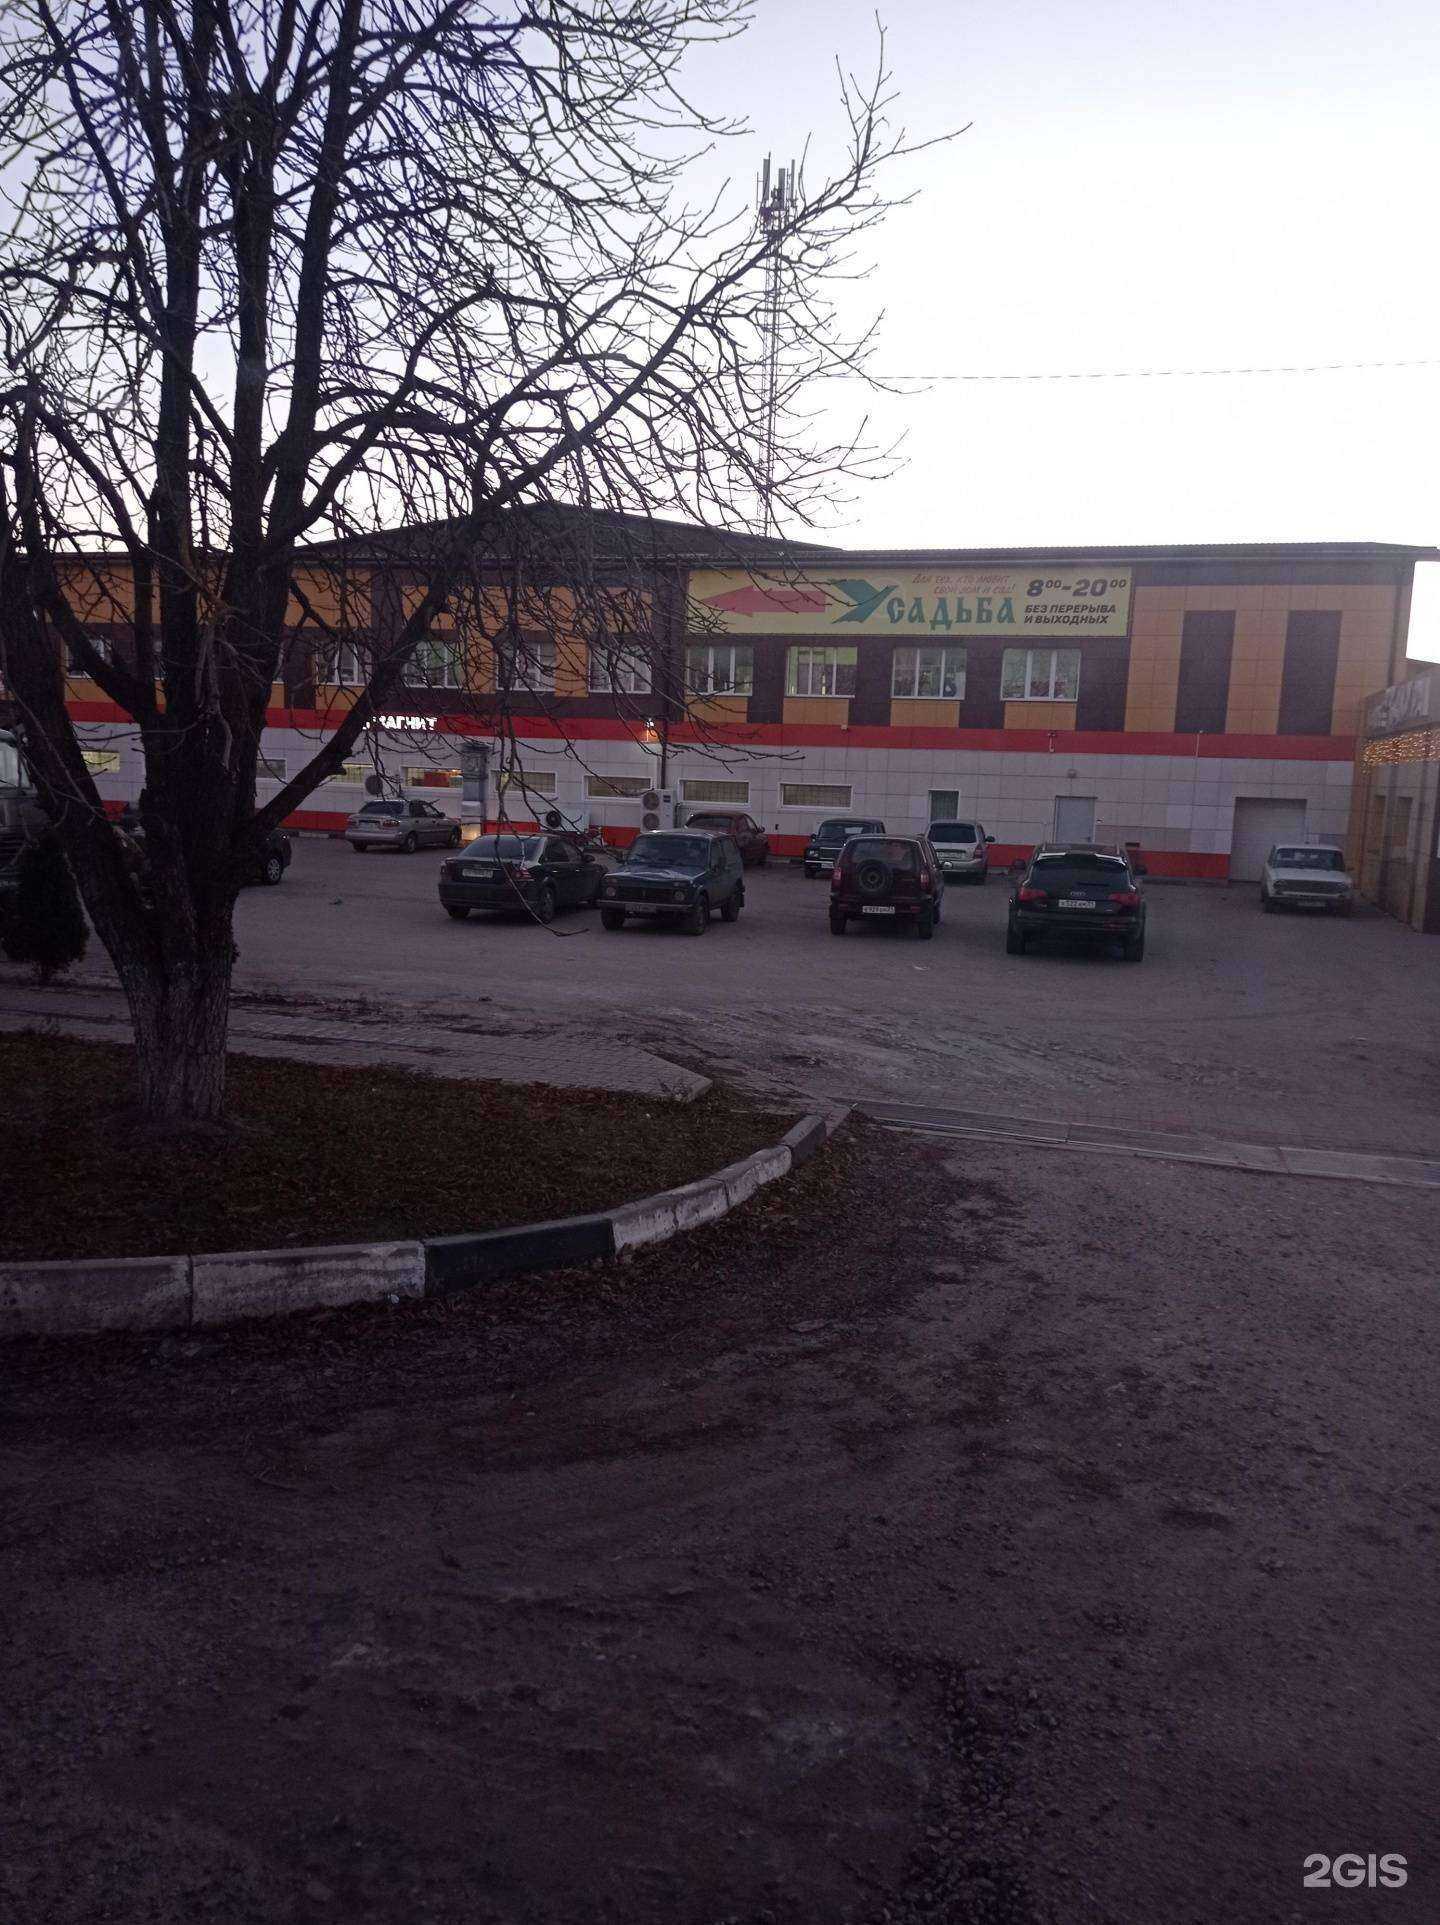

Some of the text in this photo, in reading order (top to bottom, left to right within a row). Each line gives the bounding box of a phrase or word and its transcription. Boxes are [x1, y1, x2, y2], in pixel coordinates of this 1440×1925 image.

[1025, 604, 1117, 614] БЕЗ ПЕРЕРЫВА
[1024, 615, 1109, 625] И ВЫХОДНЫХ
